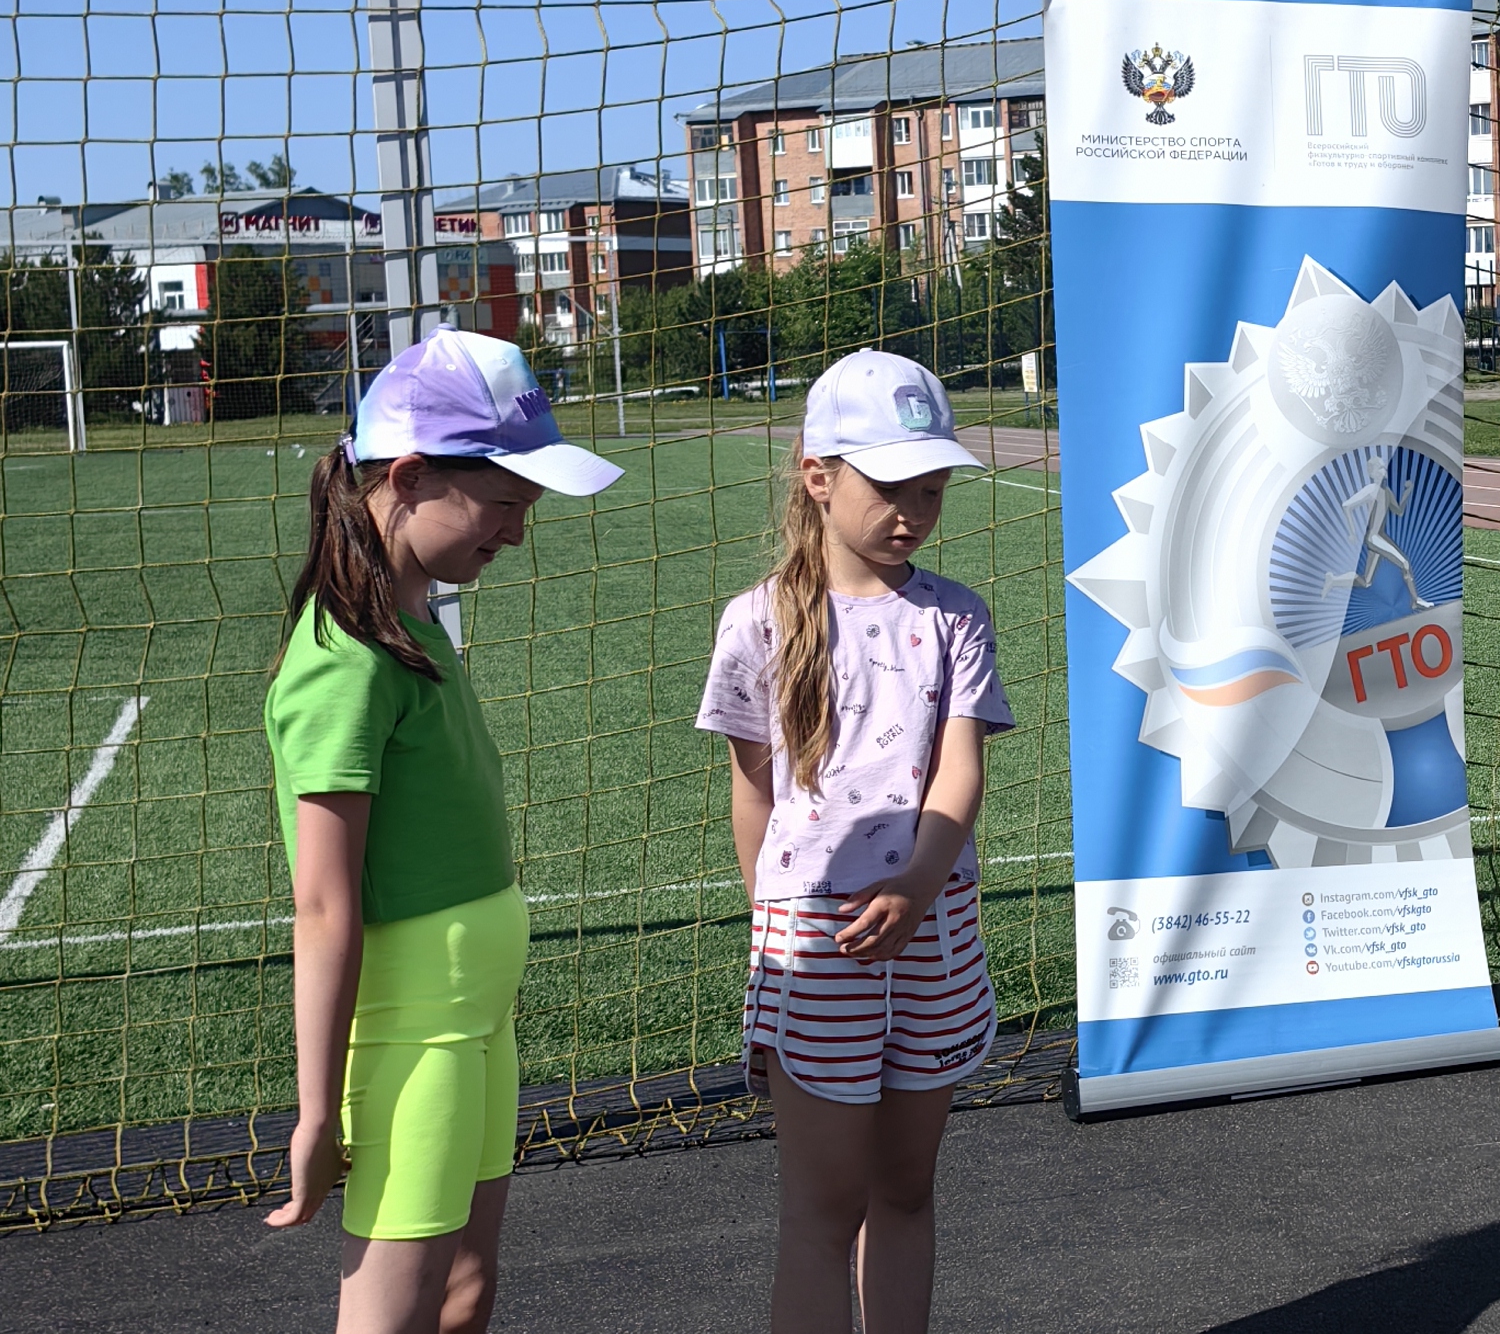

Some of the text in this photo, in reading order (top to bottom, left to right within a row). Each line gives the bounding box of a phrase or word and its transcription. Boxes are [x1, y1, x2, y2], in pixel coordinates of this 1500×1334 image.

[1303, 54, 1427, 139] ГТО
[1081, 134, 1242, 148] МИНИСТЕРСТВО СПОРТА
[1307, 142, 1369, 151] Всероссийский
[1076, 146, 1248, 162] РОССИЙСКОЙ ФЕДЕРАЦИИ
[244, 215, 320, 233] МАГНИТ
[1347, 624, 1453, 703] ГТО
[1320, 887, 1438, 904] Instagram.com/vfsk_gto
[1321, 904, 1432, 921] Facebook.com/vfskgto
[1152, 909, 1251, 934] (3842) 46-55-22
[1322, 922, 1426, 938] Twitter.com/vfsk_gto
[1153, 945, 1256, 965] официальный сайт
[1323, 941, 1407, 955] Vk.com/vfsk_gto
[1325, 952, 1461, 973] Youtube.com/vfskgtorussia
[1153, 968, 1229, 986] www.gto.ru
